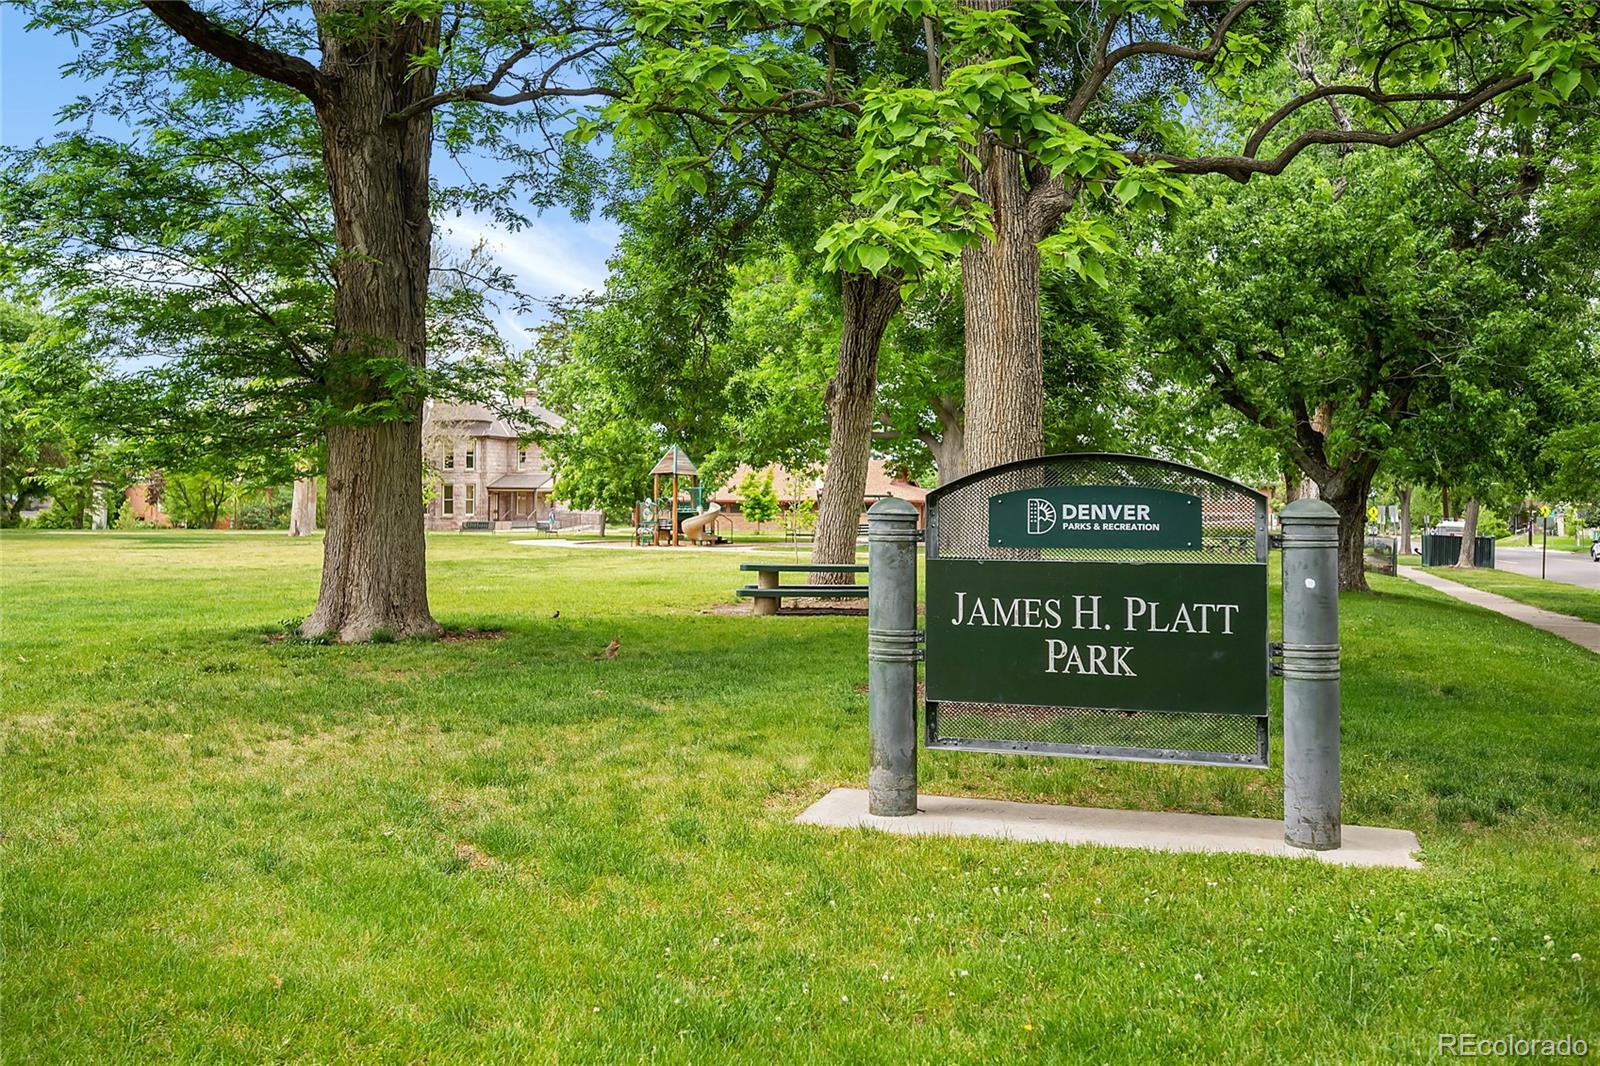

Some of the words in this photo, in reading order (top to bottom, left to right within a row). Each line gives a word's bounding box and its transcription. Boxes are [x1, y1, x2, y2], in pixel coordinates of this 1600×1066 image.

[1062, 504, 1150, 521] DENVER
[1062, 523, 1091, 531] PARKS
[1093, 523, 1101, 531] &
[1103, 523, 1160, 531] RECREATION
[951, 592, 1062, 629] JAMES
[1071, 595, 1111, 631] H.
[1123, 596, 1239, 634] PLATT
[1044, 639, 1138, 678] PARK
